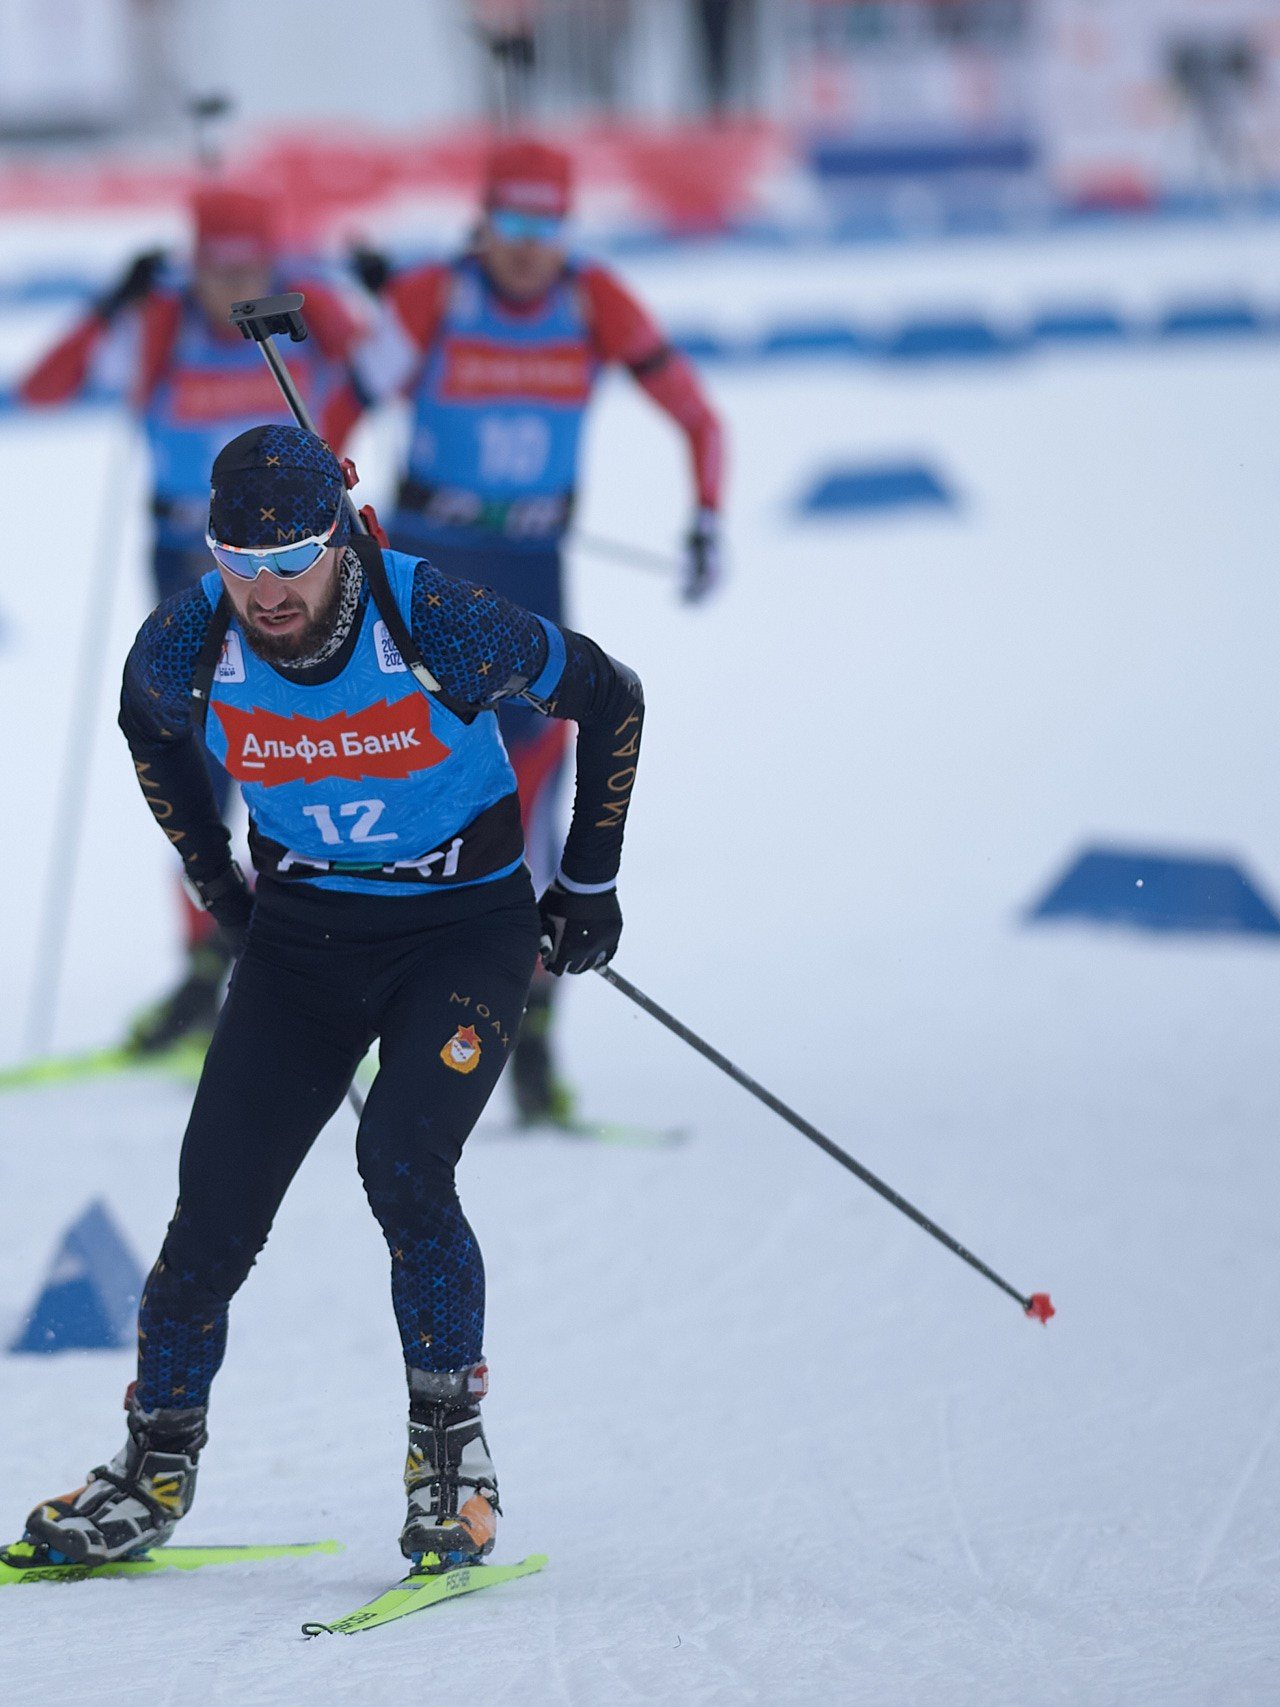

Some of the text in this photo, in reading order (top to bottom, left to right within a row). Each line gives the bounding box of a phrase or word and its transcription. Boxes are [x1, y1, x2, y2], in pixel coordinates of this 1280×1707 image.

[242, 727, 421, 766] Альфа Банк
[302, 799, 399, 846] 12
